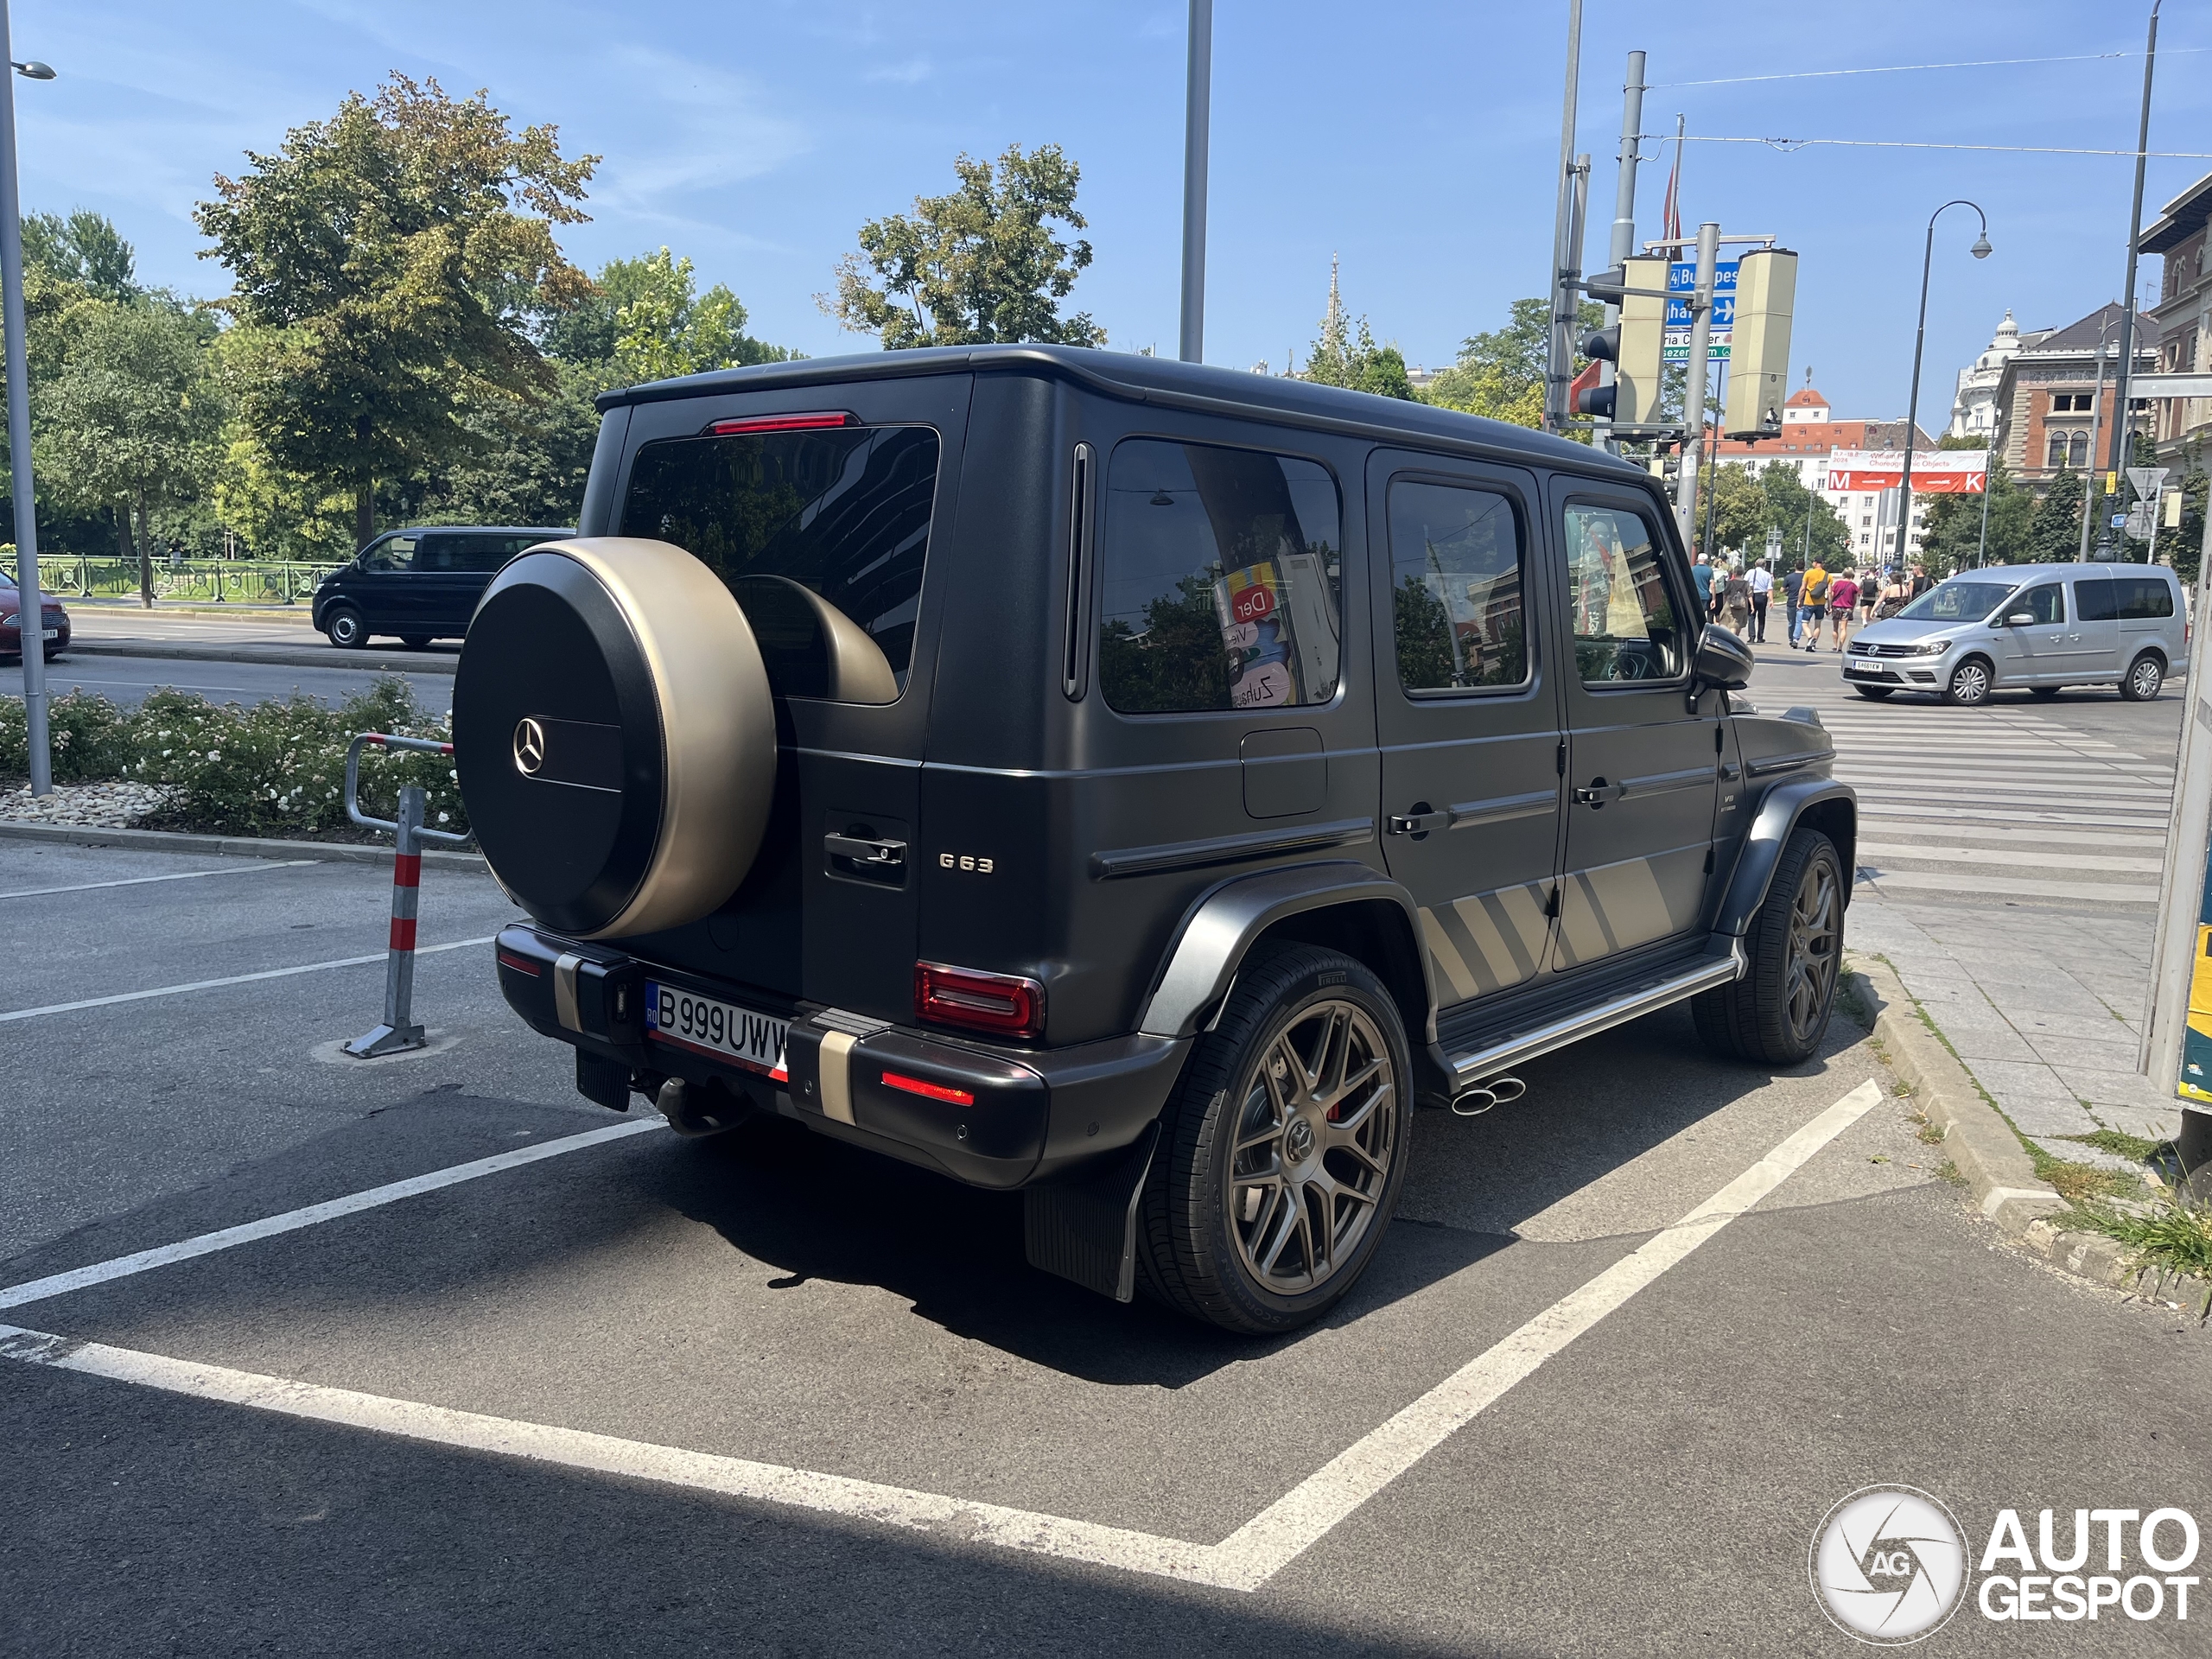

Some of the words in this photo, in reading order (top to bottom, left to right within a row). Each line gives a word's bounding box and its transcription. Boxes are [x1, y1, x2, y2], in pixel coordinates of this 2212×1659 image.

[1922, 460, 1950, 468] Objects
[1318, 970, 1347, 987] PIRELLI
[646, 1007, 658, 1024] RO
[1221, 1257, 1281, 1325] SCORPION
